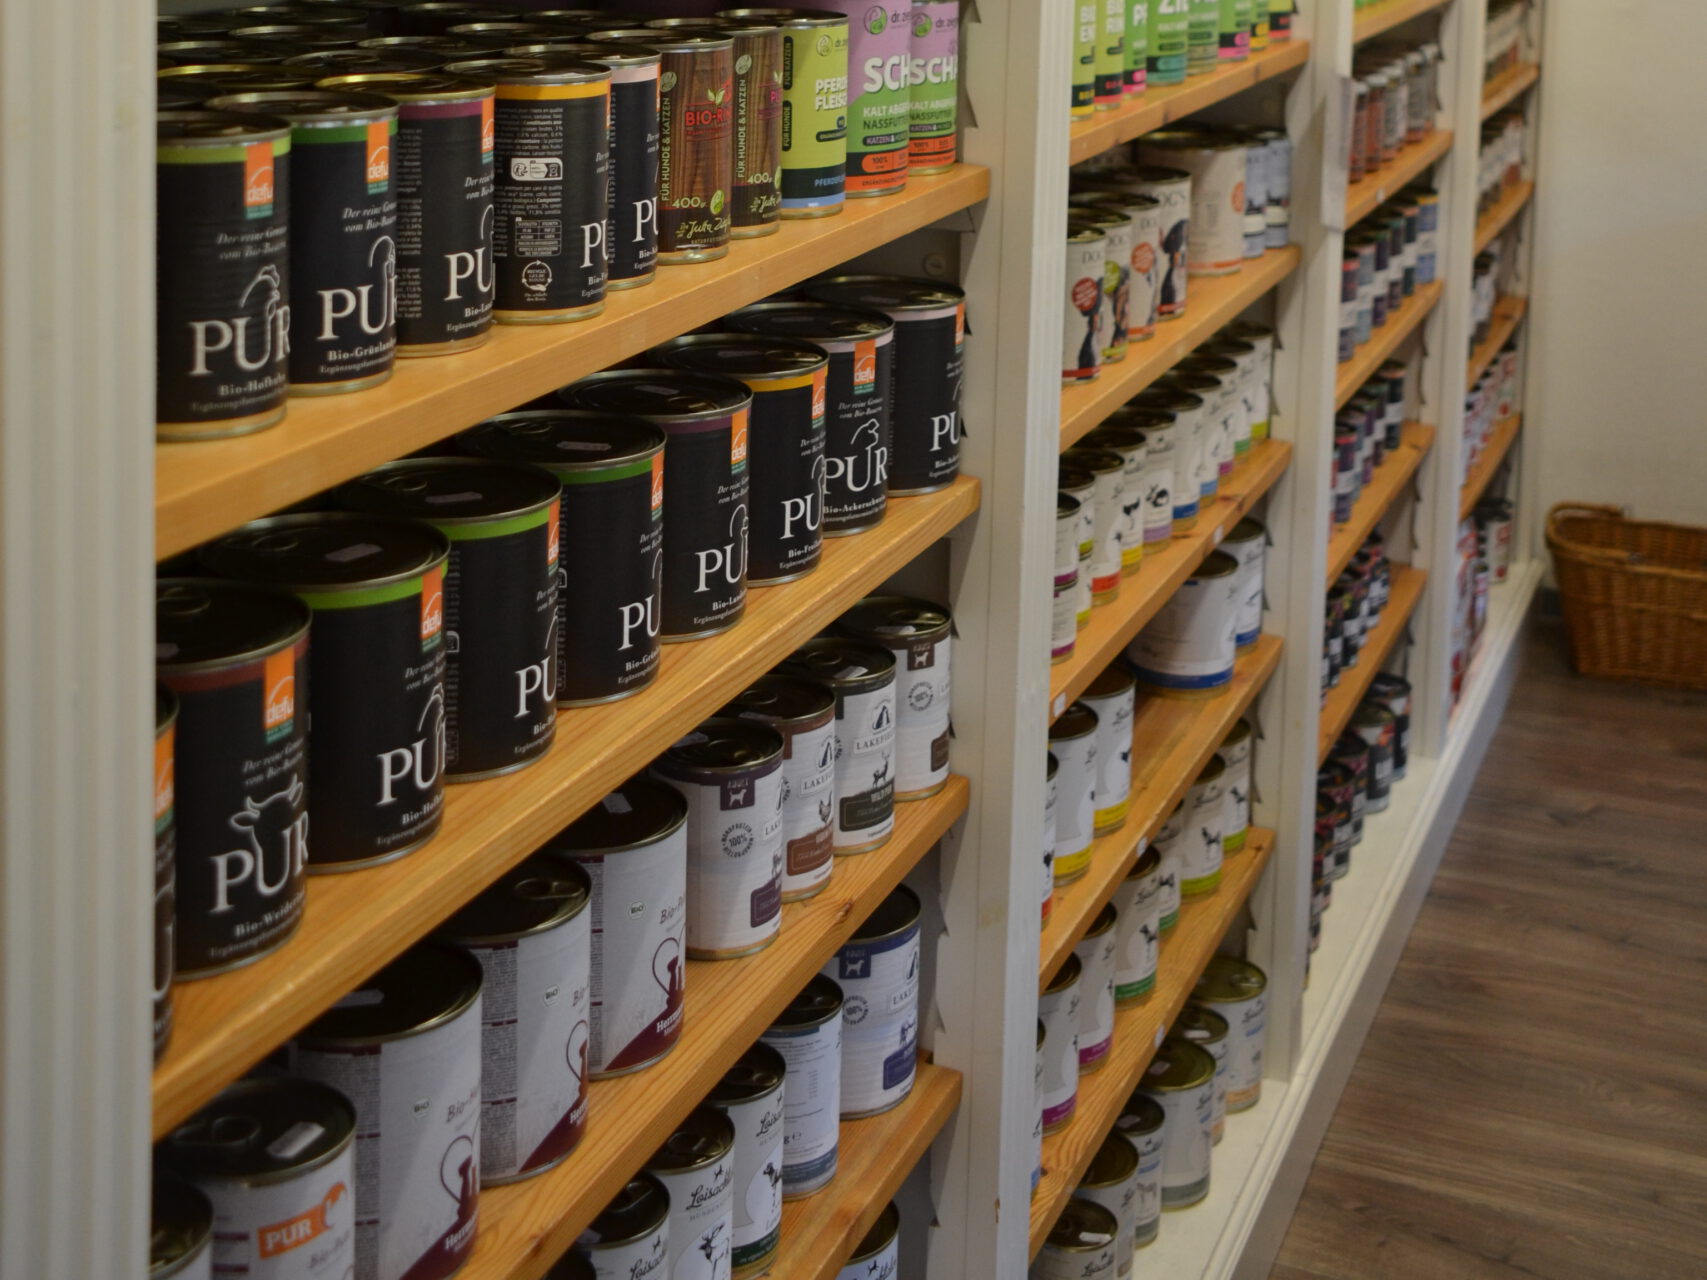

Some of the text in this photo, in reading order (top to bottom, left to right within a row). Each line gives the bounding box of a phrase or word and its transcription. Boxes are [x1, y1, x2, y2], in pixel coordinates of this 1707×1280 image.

[739, 78, 748, 117] KATZEN
[661, 97, 671, 202] FÜR HUNDE & KATZEN
[738, 128, 747, 161] HUNDE
[738, 161, 747, 178] FÜR
[342, 207, 360, 220] Der
[631, 196, 659, 242] PU
[579, 219, 609, 268] PU
[443, 247, 494, 301] PU
[188, 304, 291, 376] PUR
[929, 411, 959, 452] PU
[780, 493, 824, 541] PU
[617, 593, 661, 652] PU
[265, 694, 295, 724] defu
[513, 655, 557, 718] PU
[265, 1218, 312, 1252] PUR
